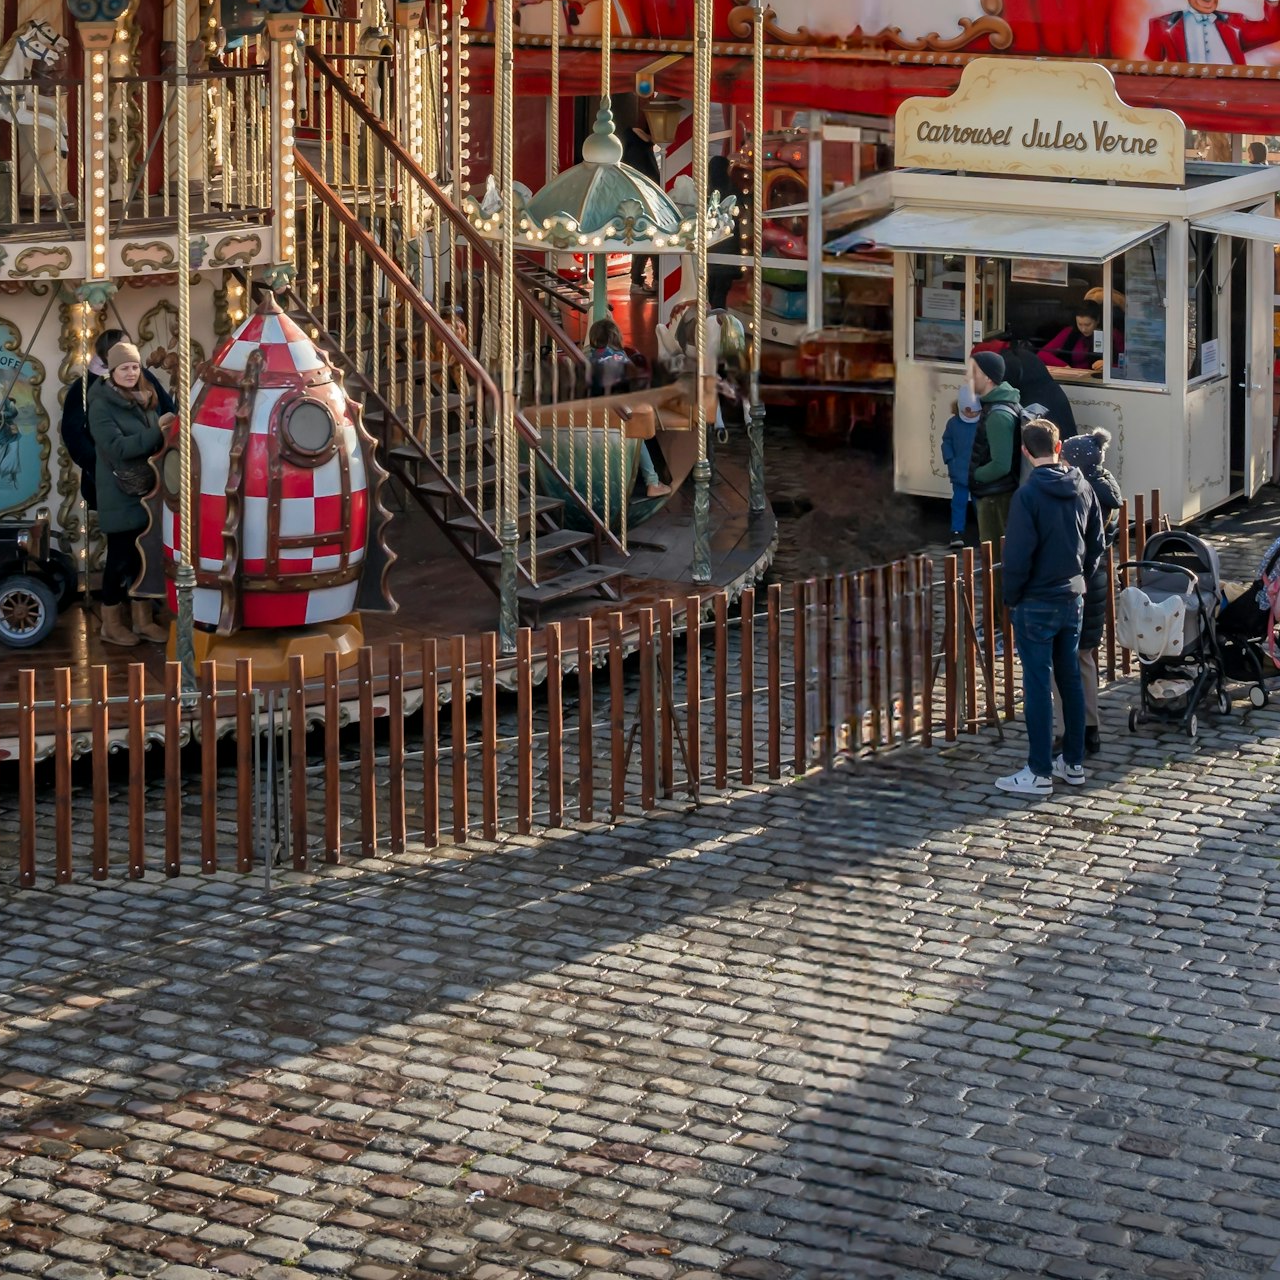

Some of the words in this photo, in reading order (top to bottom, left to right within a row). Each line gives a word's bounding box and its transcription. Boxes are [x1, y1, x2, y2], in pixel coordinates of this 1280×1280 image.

[916, 120, 1013, 147] Carrousel
[1021, 118, 1088, 151] Jules
[1093, 120, 1158, 155] Verne
